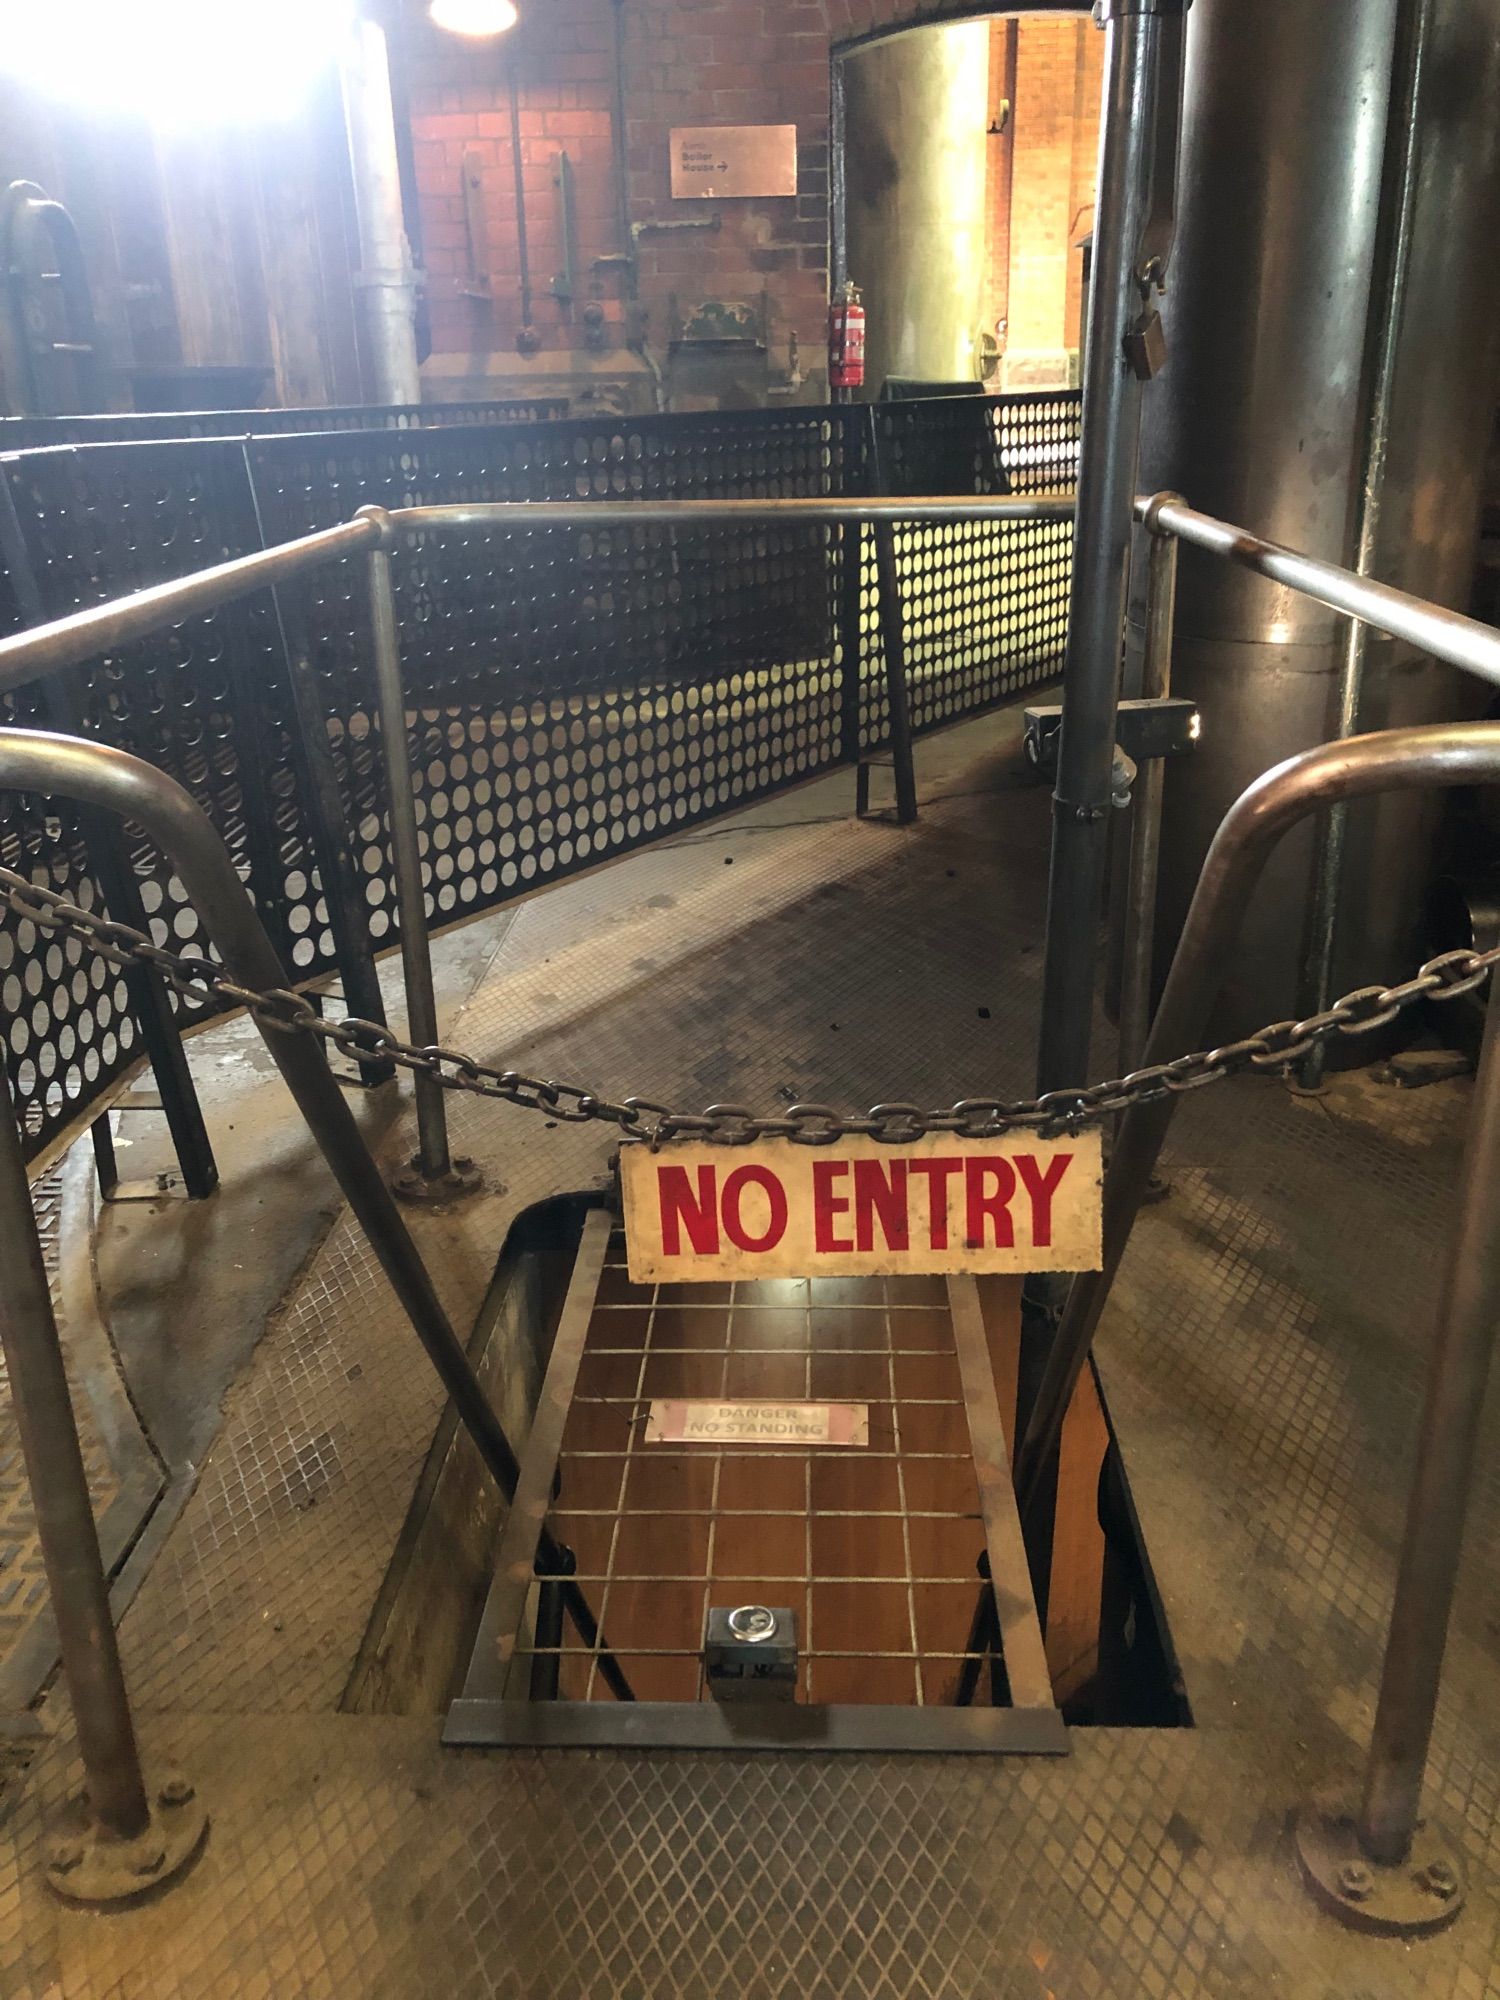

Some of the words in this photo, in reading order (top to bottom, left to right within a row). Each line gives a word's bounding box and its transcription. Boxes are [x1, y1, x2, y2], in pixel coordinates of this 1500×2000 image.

[657, 1164, 788, 1256] NO
[813, 1154, 1074, 1253] ENTRY
[719, 1407, 799, 1418] DANGER
[690, 1422, 720, 1433] NO
[725, 1422, 824, 1434] STANDING
